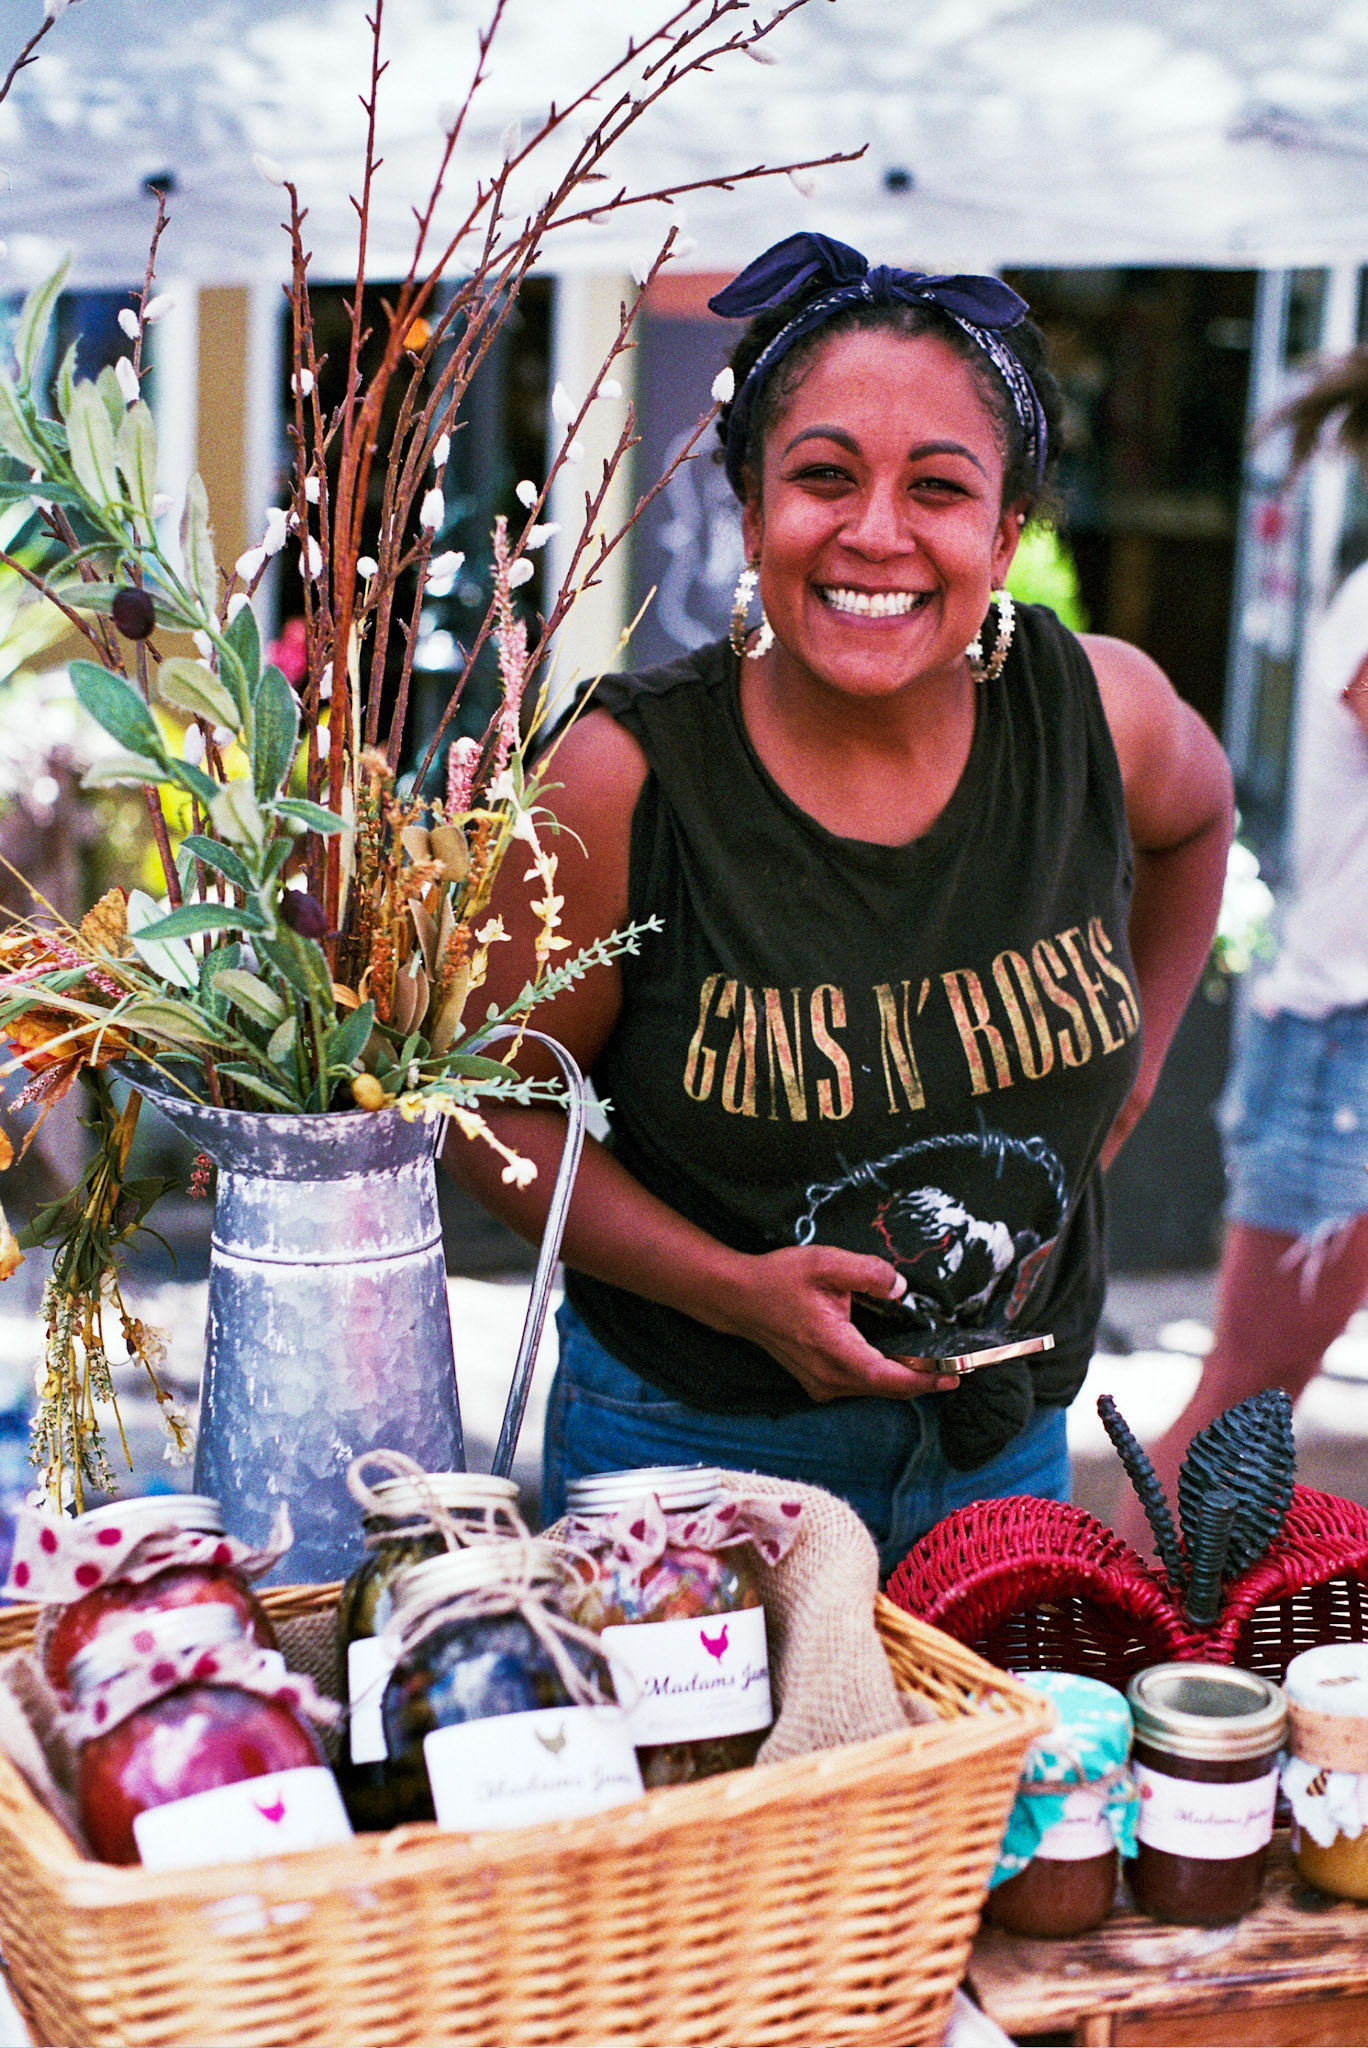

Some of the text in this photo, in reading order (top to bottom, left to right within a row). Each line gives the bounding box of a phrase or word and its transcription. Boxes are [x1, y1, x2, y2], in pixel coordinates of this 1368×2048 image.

[683, 972, 854, 1122] GUNS
[940, 916, 1140, 1097] ROSES
[645, 1672, 735, 1696] Madams
